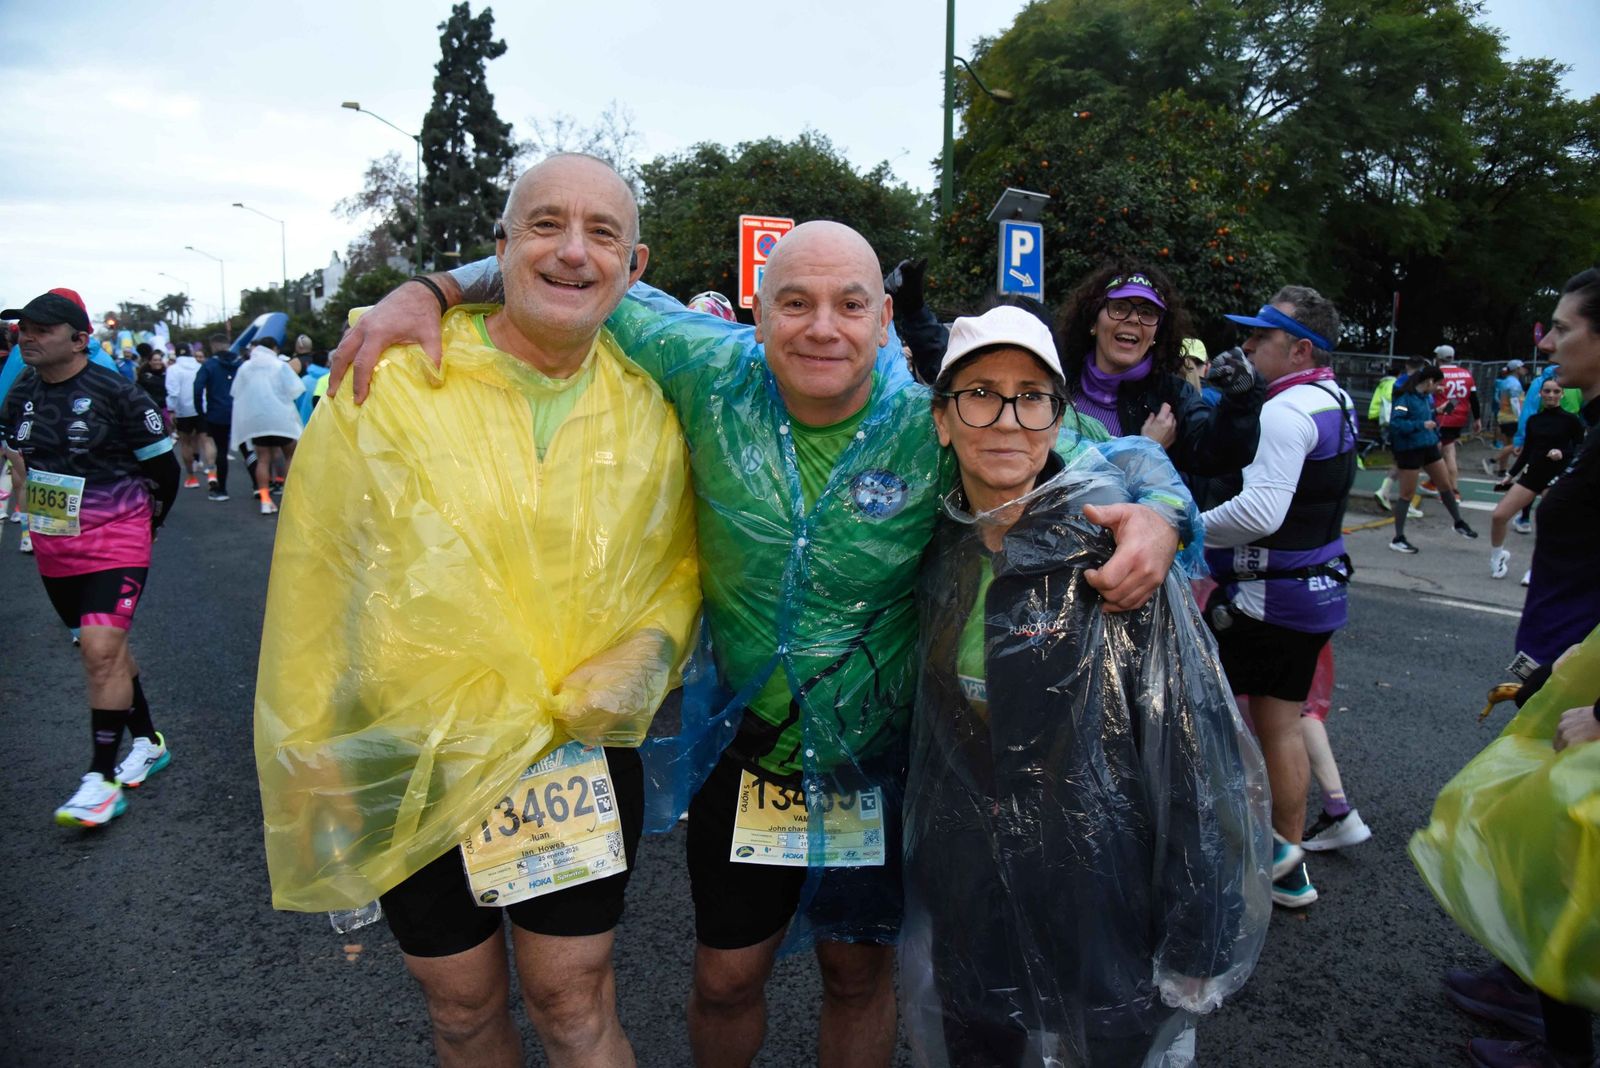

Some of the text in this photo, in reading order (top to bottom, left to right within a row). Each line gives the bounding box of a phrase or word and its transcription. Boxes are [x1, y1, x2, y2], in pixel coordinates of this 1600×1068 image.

[1011, 229, 1034, 267] P
[1446, 380, 1468, 399] 25
[26, 485, 67, 510] 11363
[479, 775, 595, 843] 13462
[529, 831, 550, 843] Juan
[768, 825, 787, 833] John
[521, 841, 566, 857] Ian Howes
[782, 852, 804, 860] HOKA
[528, 877, 553, 890] HOKA
